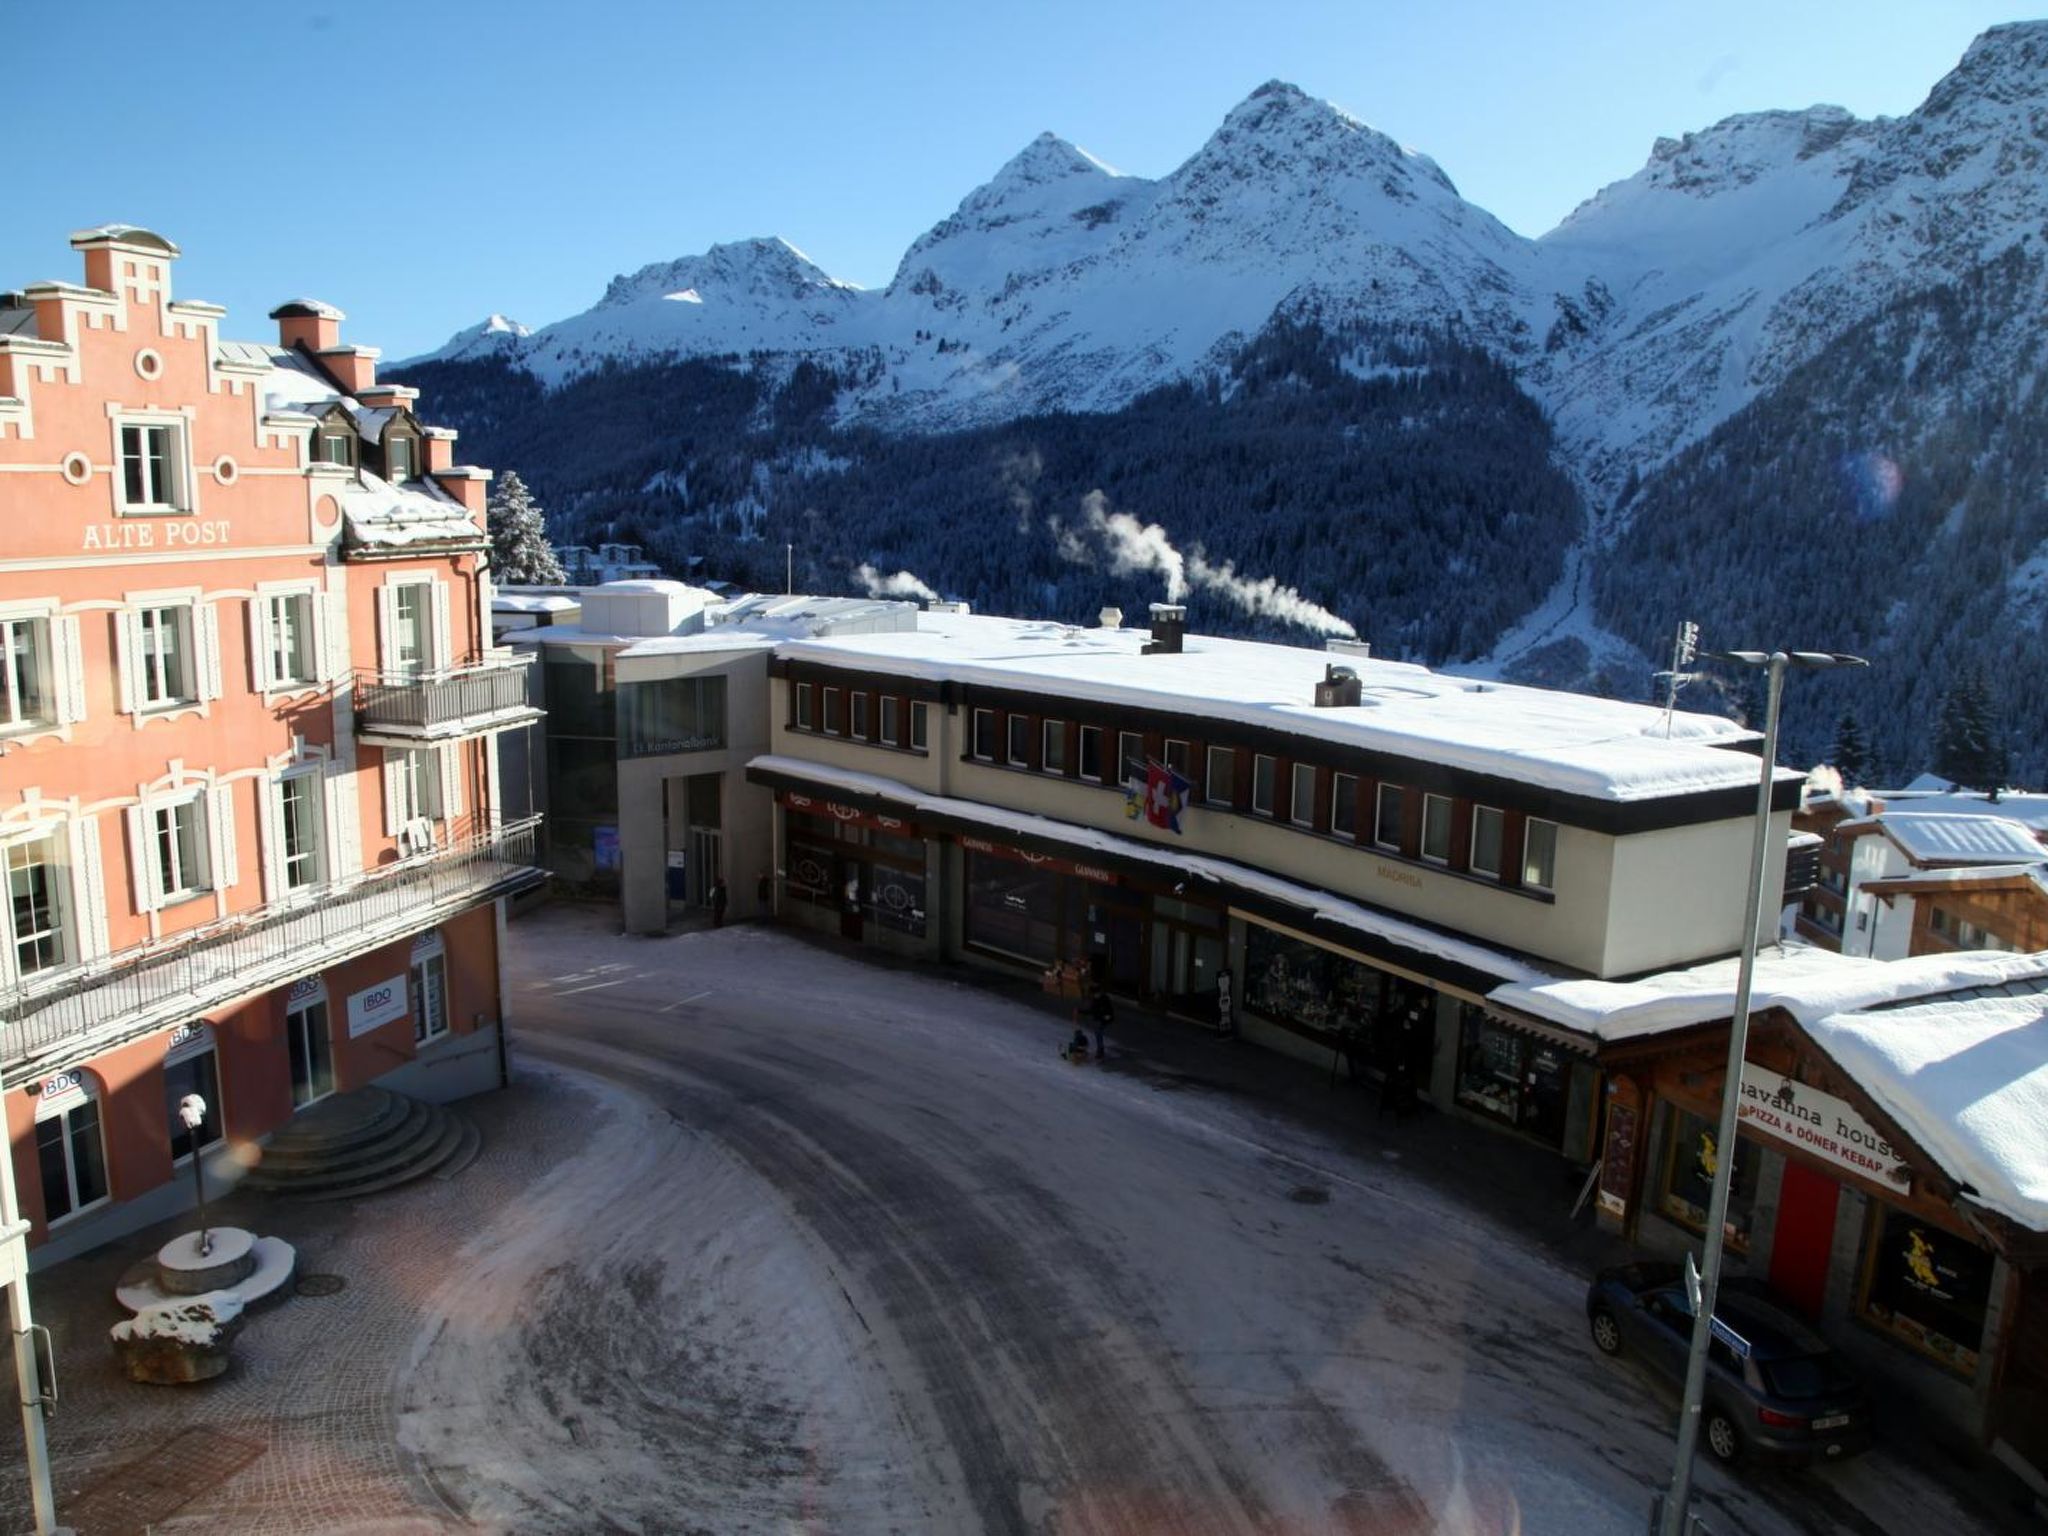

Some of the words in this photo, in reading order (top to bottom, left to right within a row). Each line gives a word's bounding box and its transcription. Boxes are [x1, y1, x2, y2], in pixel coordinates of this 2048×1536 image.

[82, 523, 154, 549] ALTE
[165, 520, 230, 546] POST
[367, 988, 392, 1007] BDO
[46, 1070, 82, 1095] BDO
[1750, 1105, 1782, 1130] PIZZA
[1784, 1122, 1794, 1134] &
[1797, 1126, 1838, 1155] DÖNER
[1841, 1146, 1884, 1173] KEBAP
